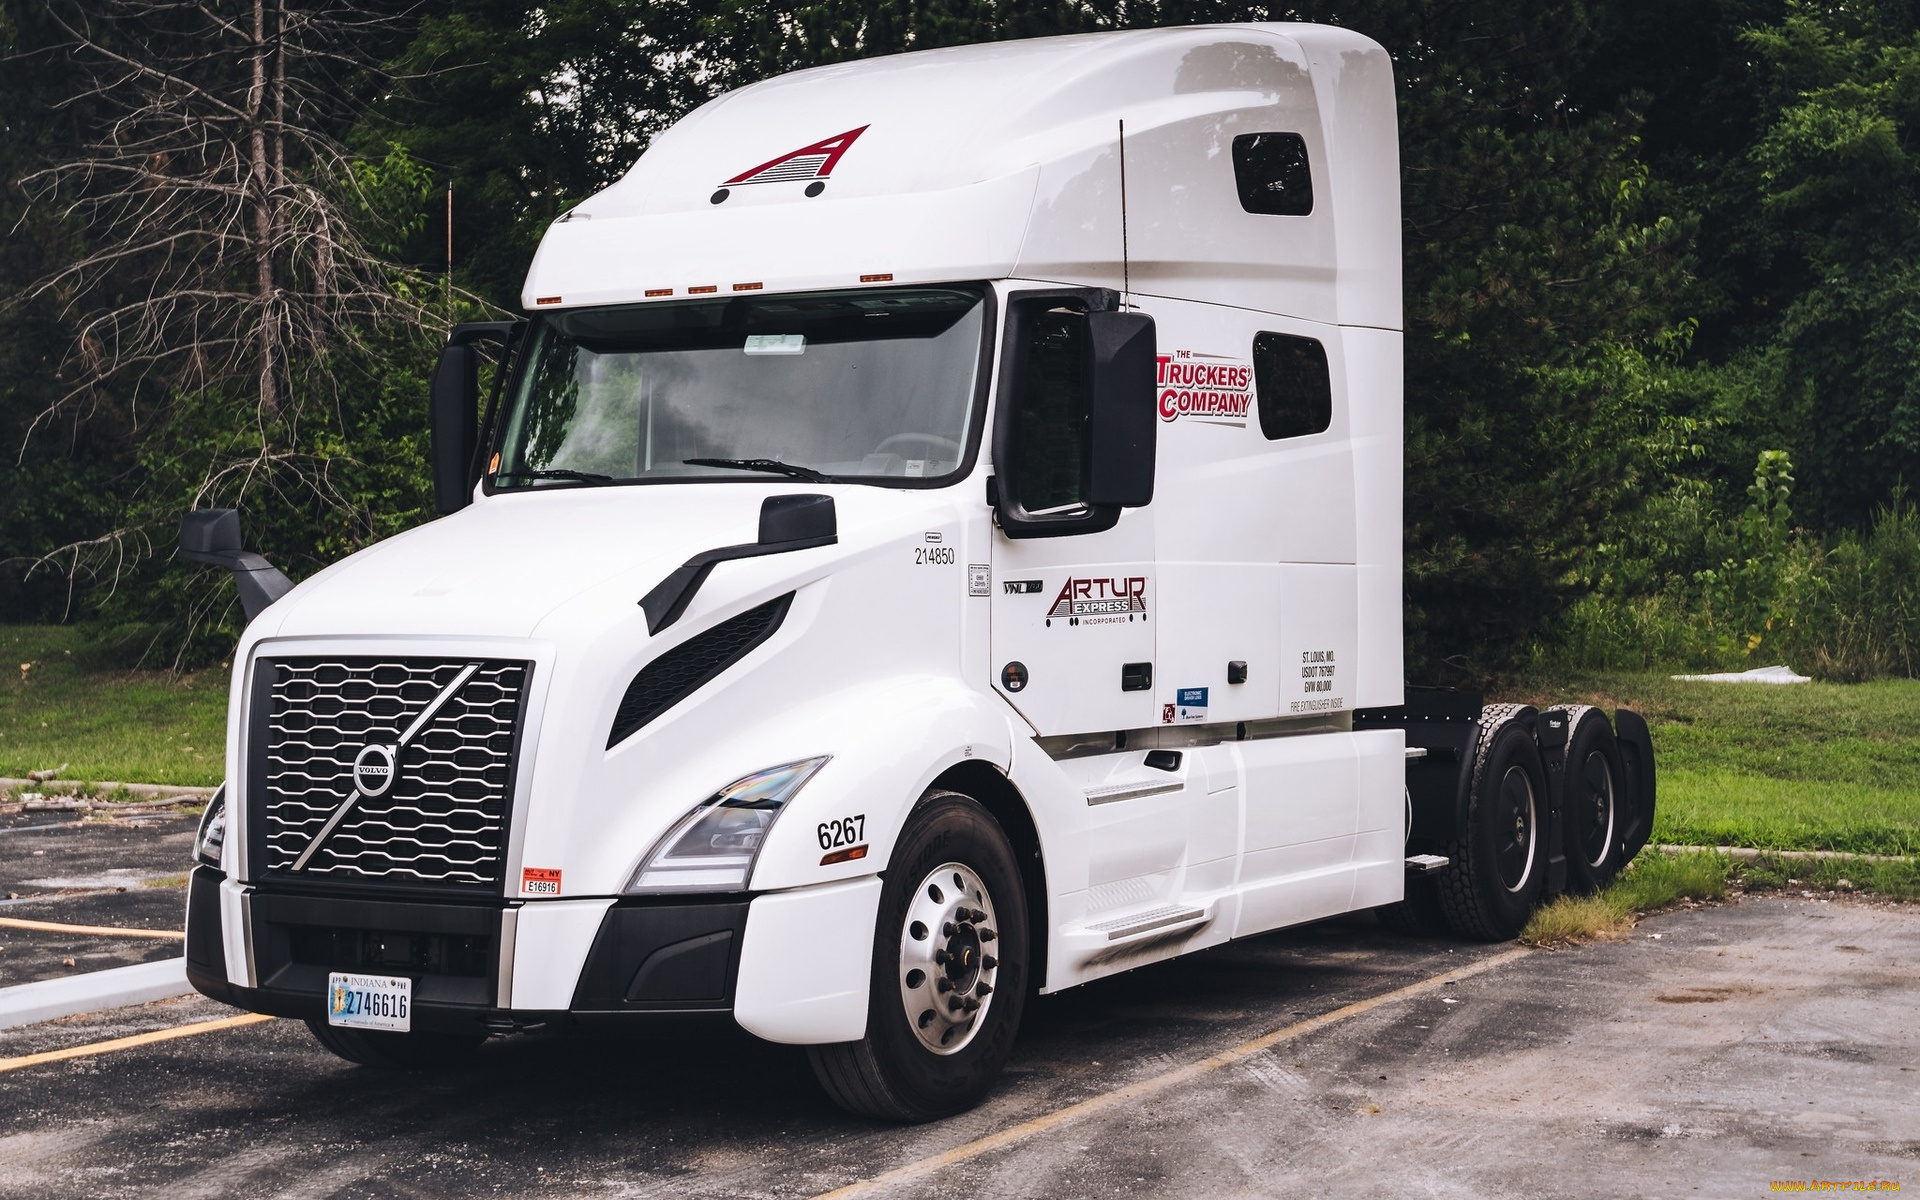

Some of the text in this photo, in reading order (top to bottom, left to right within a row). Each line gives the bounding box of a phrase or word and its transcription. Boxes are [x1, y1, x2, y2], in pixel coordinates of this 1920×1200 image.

[1176, 350, 1191, 359] THE
[1159, 389, 1252, 419] COMPANY
[915, 547, 955, 565] 214850
[1047, 576, 1147, 616] ARTUR
[1074, 601, 1130, 614] EXPRESS
[1082, 616, 1127, 626] INCORPORATED
[1301, 665, 1318, 679] USDOT
[1304, 681, 1316, 693] GVW
[1290, 697, 1344, 713] FIRE EXTINGUISHER INSIDE
[358, 766, 389, 774] VOLVO
[817, 814, 866, 851] 6267
[529, 881, 556, 893] E16916
[351, 977, 387, 988] INDIANA
[347, 991, 407, 1018] 2746616
